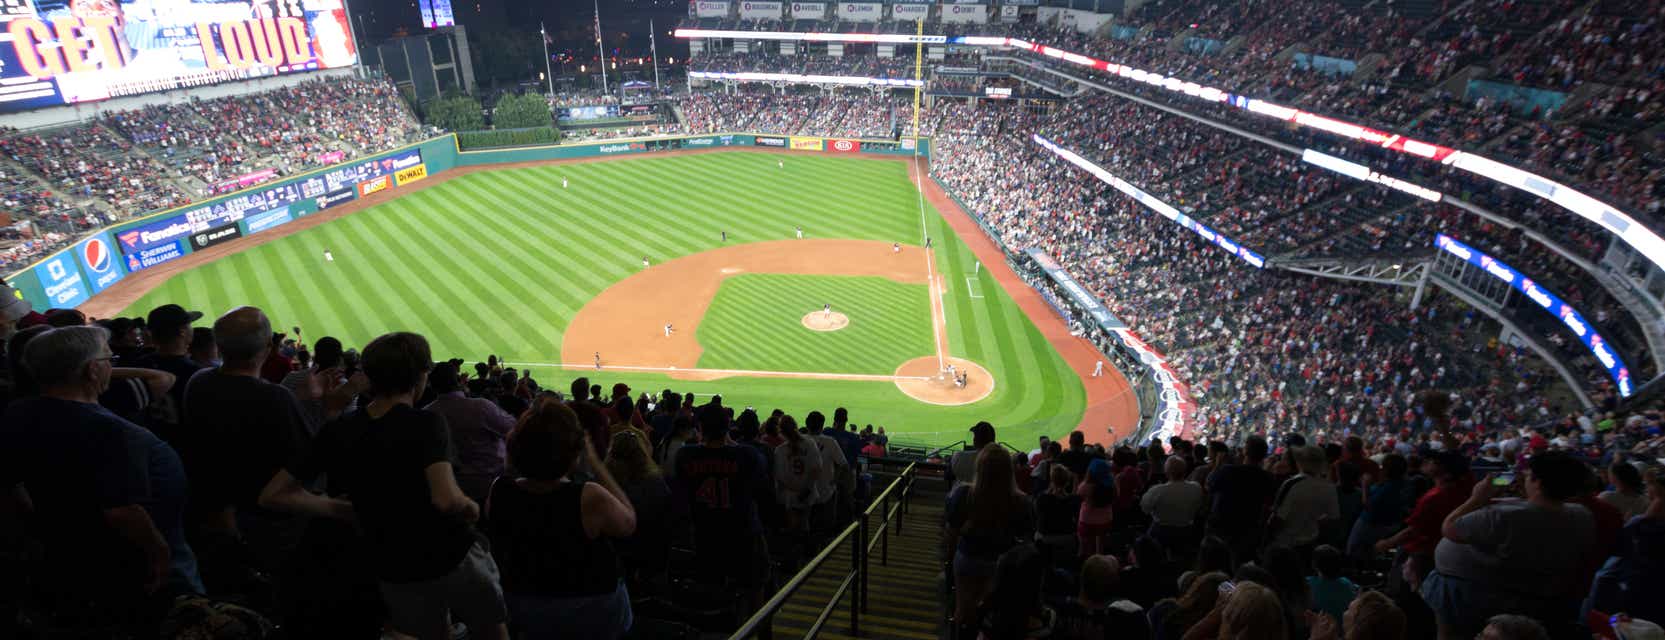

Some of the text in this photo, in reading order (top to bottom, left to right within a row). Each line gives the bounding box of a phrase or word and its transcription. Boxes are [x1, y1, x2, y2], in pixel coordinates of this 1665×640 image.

[8, 15, 310, 79] GET LOUD
[600, 144, 629, 152] KeyBank
[140, 222, 191, 244] Fanatics
[140, 242, 177, 258] SHERWIN
